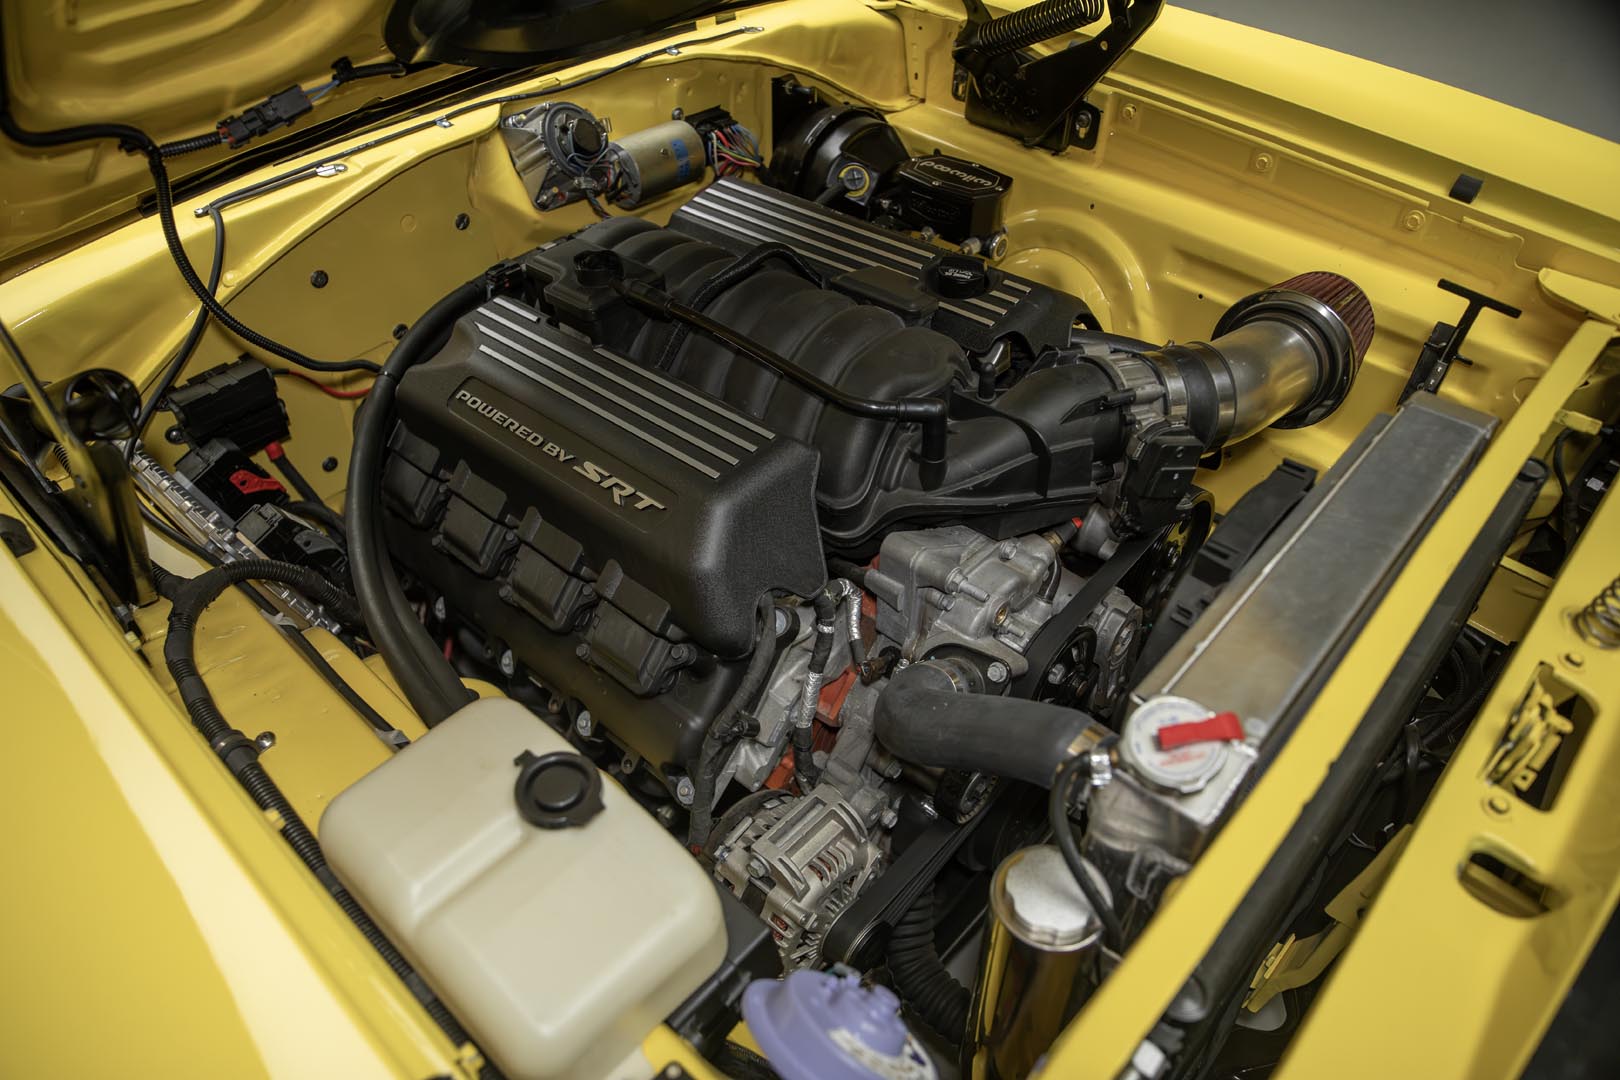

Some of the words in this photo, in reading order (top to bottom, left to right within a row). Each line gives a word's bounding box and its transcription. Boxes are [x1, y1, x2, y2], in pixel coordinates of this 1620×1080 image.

[920, 161, 993, 186] wilwood
[455, 389, 544, 447] POWERED
[542, 442, 576, 462] BY
[572, 461, 667, 511] SRT
